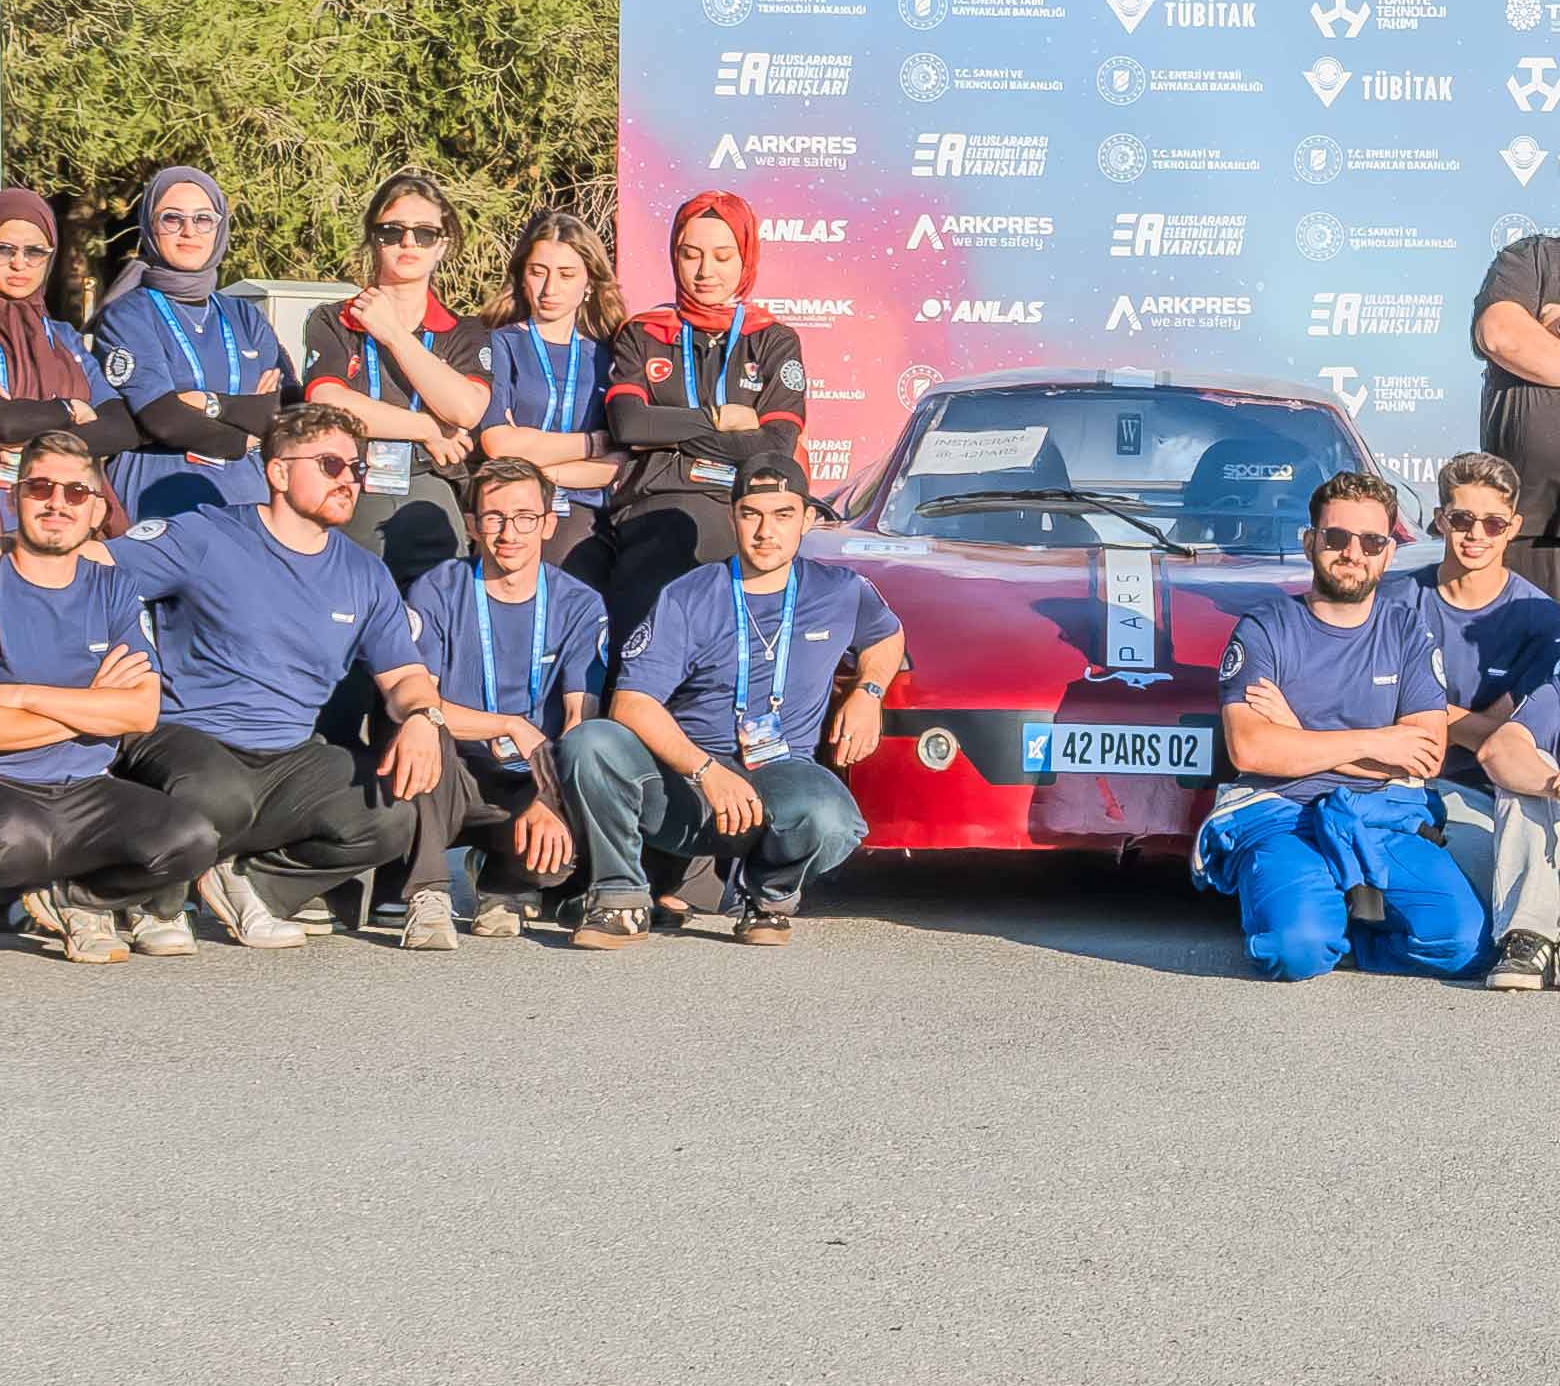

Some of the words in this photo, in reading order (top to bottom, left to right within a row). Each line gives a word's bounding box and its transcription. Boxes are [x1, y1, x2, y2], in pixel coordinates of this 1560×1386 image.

[767, 79, 850, 98] YARIŞLARI
[1362, 70, 1453, 102] TÜBİTAK
[745, 135, 857, 156] ARKPRES
[755, 156, 777, 168] we
[778, 156, 801, 168] are
[803, 154, 848, 172] safety
[964, 159, 1046, 178] YARIŞLARI
[759, 219, 849, 243] ANLAS
[943, 215, 1053, 236] ARKPRES
[952, 235, 973, 248] we
[975, 235, 998, 248] are
[1000, 234, 1045, 251] safety
[1162, 239, 1243, 258] YARIŞLARI
[752, 298, 856, 316] TENMAK
[951, 300, 1045, 323] ANLAS
[1141, 295, 1251, 315] ARKPRES
[1151, 316, 1173, 328] we
[1174, 316, 1196, 328] are
[1223, 463, 1293, 481] sparco
[1062, 731, 1092, 765] 42
[1100, 732, 1162, 767] PARS
[1168, 733, 1199, 768] 02
